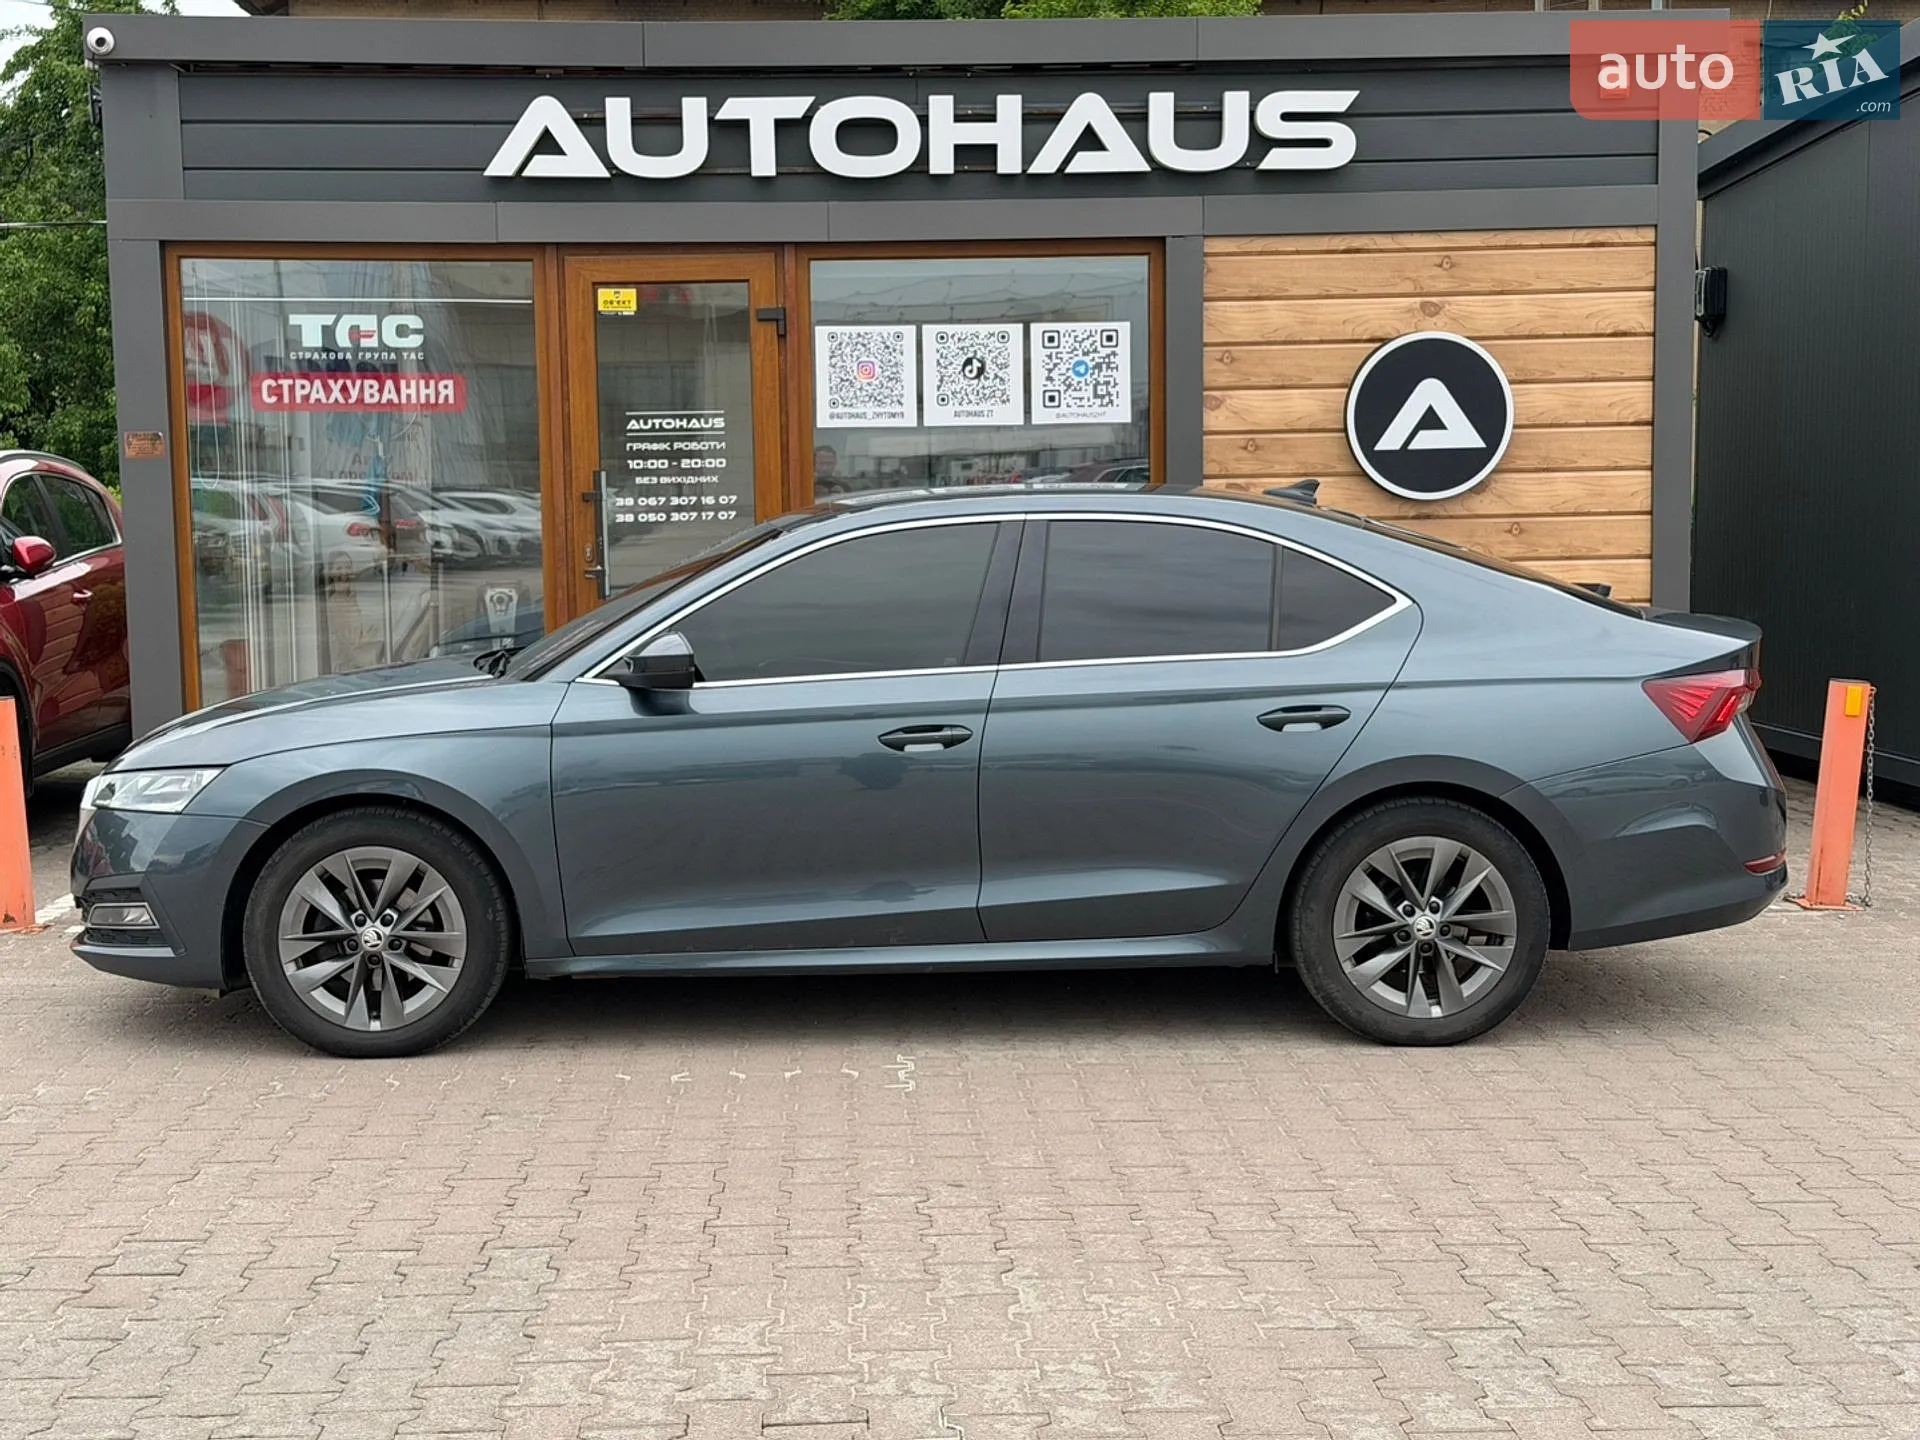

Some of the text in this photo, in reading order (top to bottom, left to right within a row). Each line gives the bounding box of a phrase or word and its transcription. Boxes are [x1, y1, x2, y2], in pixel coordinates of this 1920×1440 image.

[483, 90, 1360, 179] AUTOHAUS
[289, 351, 425, 361] СТРАХОВА ГРУПА ТАС
[260, 378, 455, 405] СТРАХУВАННЯ
[626, 417, 726, 430] AUTOHAUS
[625, 441, 726, 451] ГРАФІК РОБОТИ
[626, 458, 669, 469] 10:00
[680, 458, 727, 468] 20:00
[635, 474, 720, 485] БЕЗ ВИХІДНИХ
[615, 495, 737, 507] 38 067 307 16 07
[615, 510, 737, 523] 38 050 307 17 07
